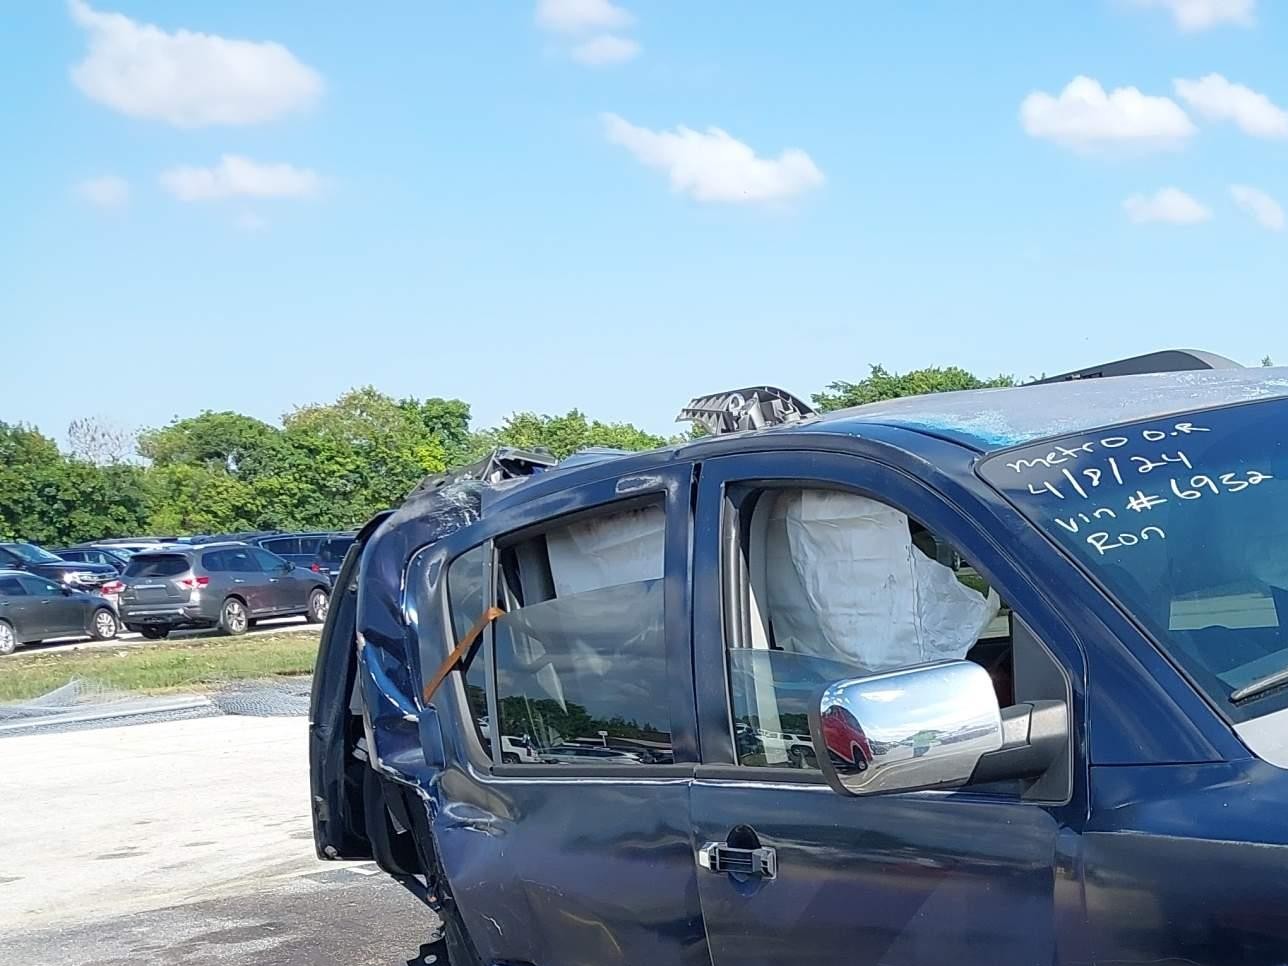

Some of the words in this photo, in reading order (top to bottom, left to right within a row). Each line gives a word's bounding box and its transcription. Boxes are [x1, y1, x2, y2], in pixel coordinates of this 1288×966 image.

[1028, 451, 1193, 499] 4/8/24
[1125, 490, 1168, 512] #
[1170, 470, 1274, 500] 6932
[1086, 526, 1166, 555] Ron
